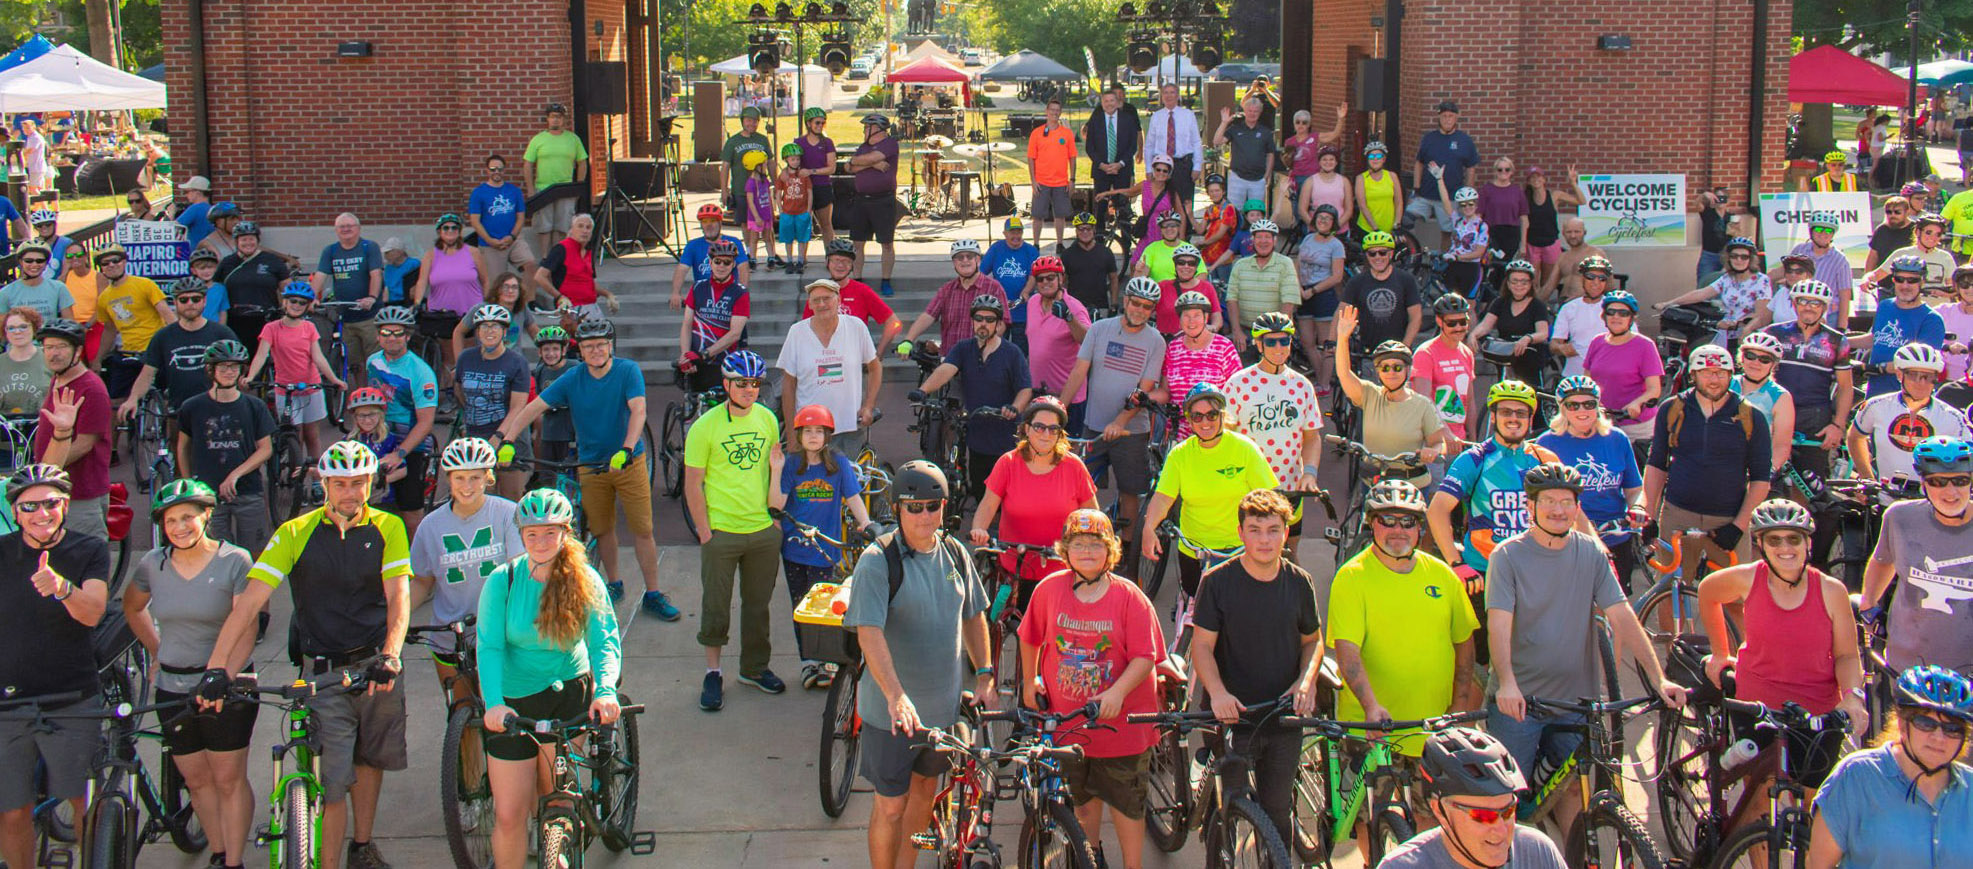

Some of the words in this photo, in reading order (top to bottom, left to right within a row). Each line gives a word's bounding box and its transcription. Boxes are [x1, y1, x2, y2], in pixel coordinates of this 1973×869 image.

[1587, 183, 1677, 196] WELCOME
[1588, 198, 1676, 211] CYCLISTS!
[1774, 209, 1859, 224] CHE-IN
[1608, 226, 1656, 244] Cyclefest
[11, 372, 29, 382] GO
[1057, 612, 1113, 633] Chautauqua
[1536, 752, 1577, 806] TREK
